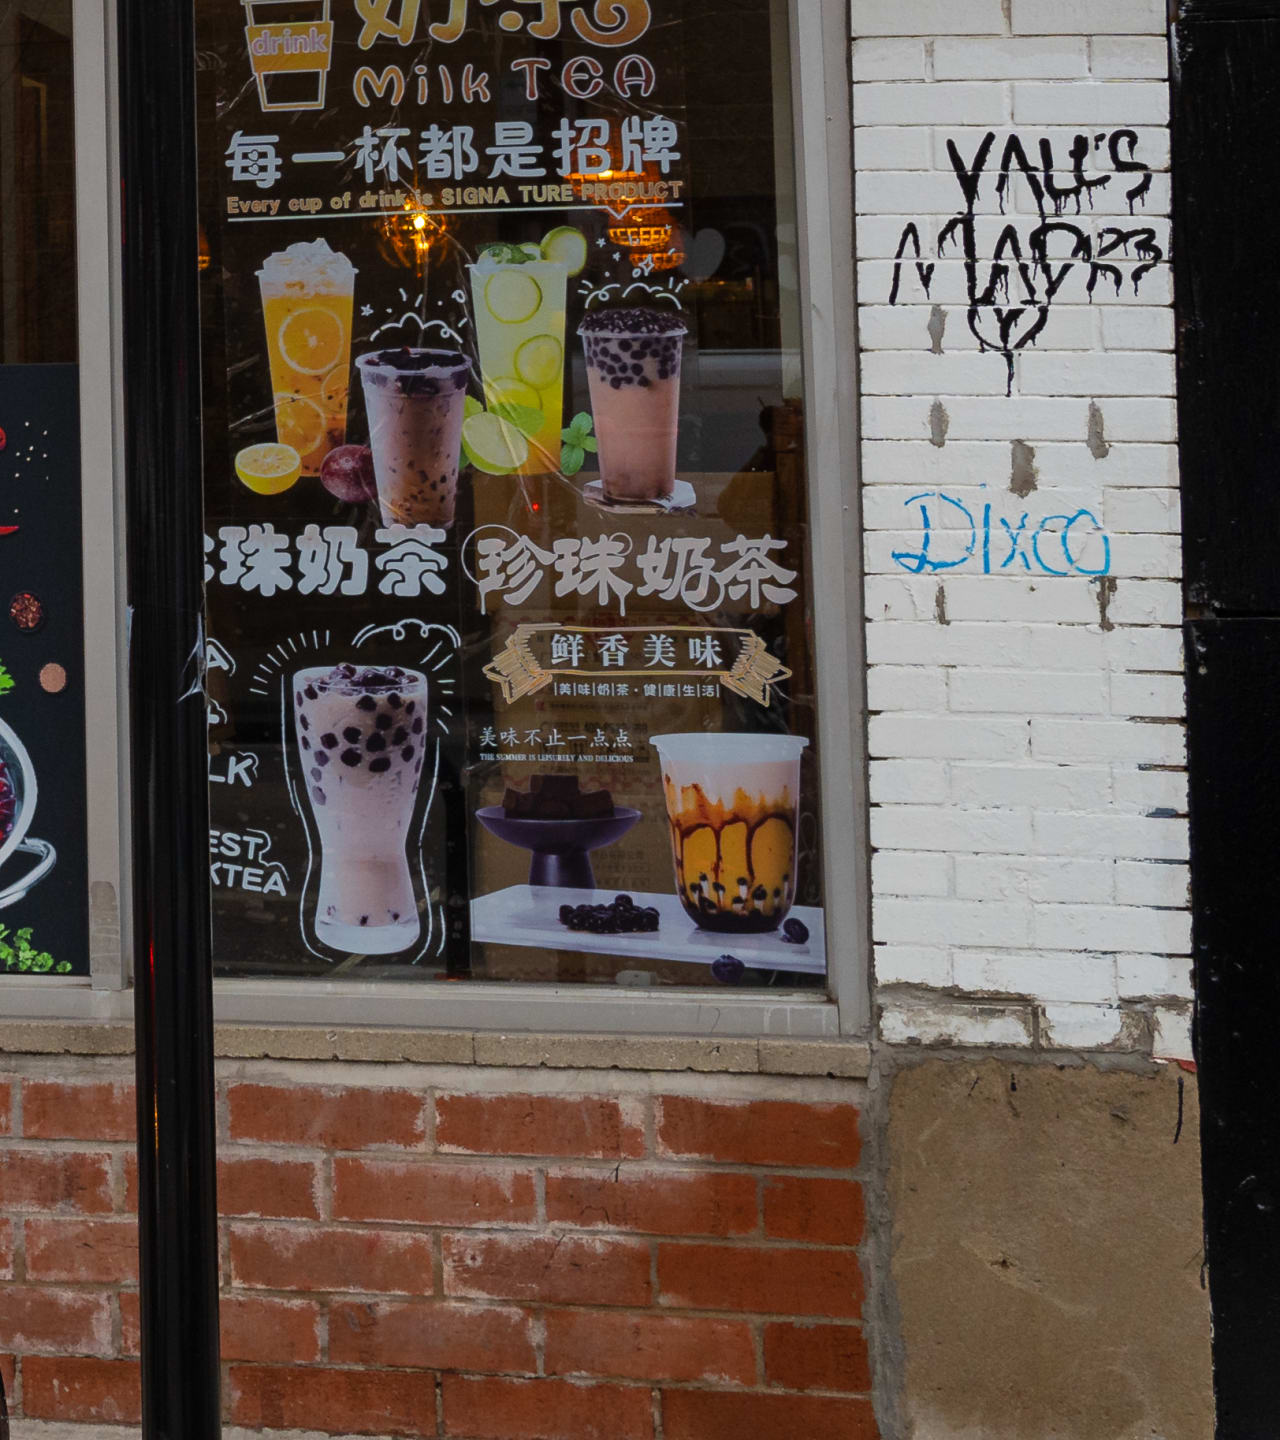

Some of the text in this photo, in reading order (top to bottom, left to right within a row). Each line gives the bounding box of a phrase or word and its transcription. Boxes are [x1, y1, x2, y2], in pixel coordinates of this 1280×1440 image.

[251, 26, 328, 56] drink
[353, 54, 656, 108] Milk TEA
[225, 114, 681, 189] 每一杯都是招牌
[227, 196, 280, 217] Every
[288, 195, 323, 215] cup
[329, 192, 352, 210] of
[358, 189, 410, 209] drink
[441, 186, 511, 206] SIGNA
[580, 181, 684, 202] PRODUCT
[205, 521, 449, 598] 珠奶茶
[477, 532, 798, 618] 珍珠奶茶
[550, 632, 724, 668] 鲜香美味
[479, 726, 633, 749] 美味不止一点点
[209, 752, 253, 788] LK
[210, 860, 288, 897] KTEA
